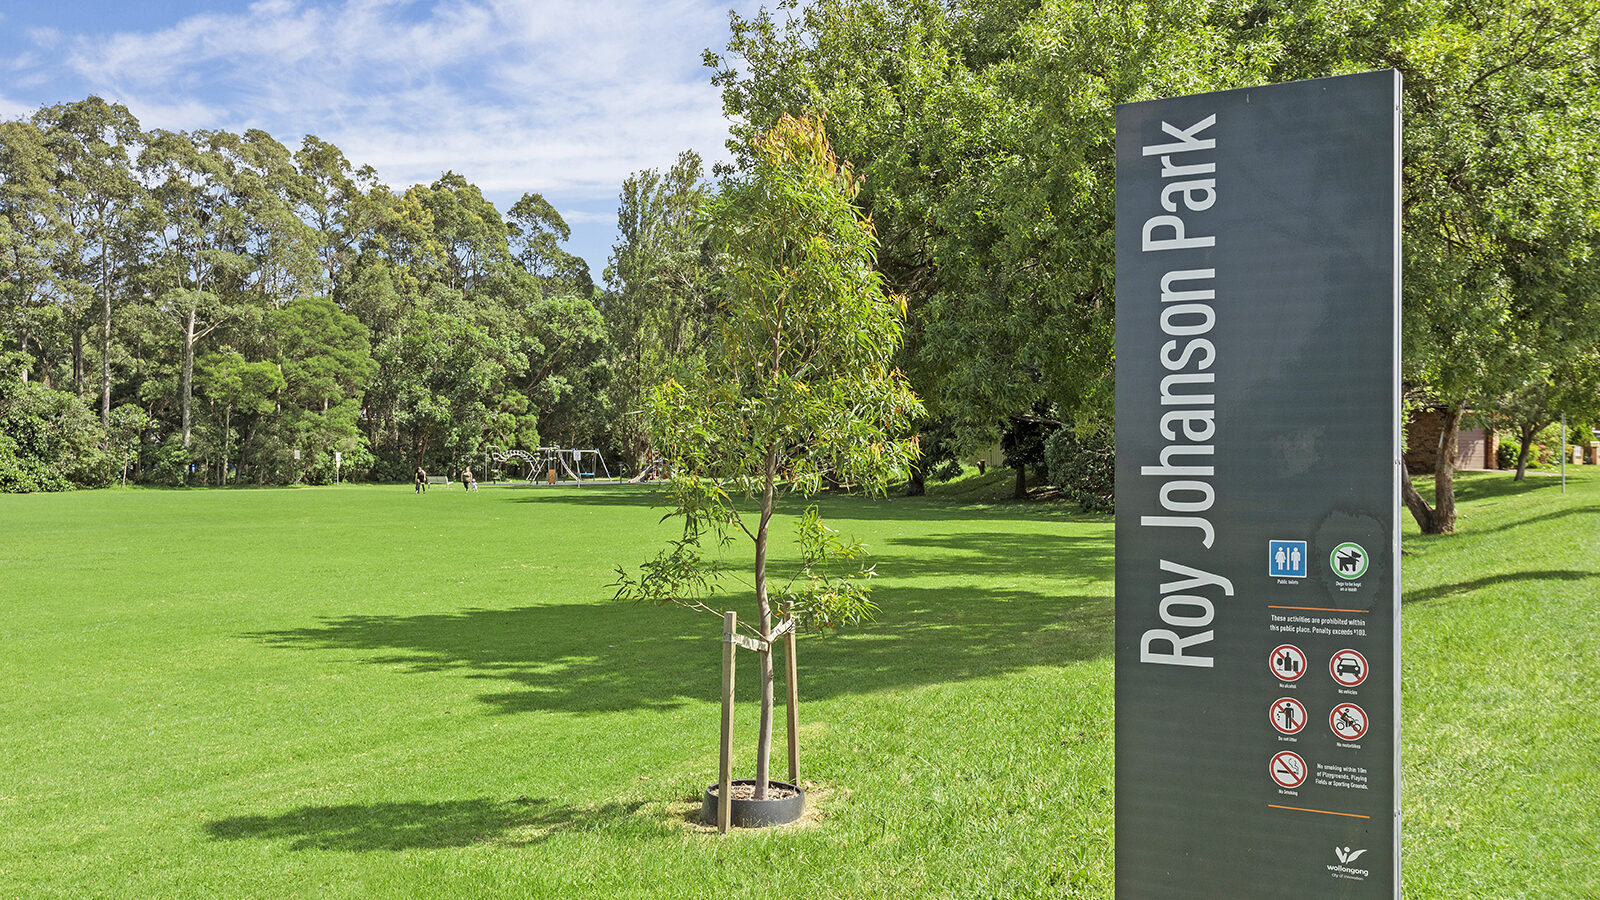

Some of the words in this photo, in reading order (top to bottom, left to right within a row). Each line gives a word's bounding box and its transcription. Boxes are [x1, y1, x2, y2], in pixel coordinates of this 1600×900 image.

[1141, 112, 1217, 253] Park
[1140, 267, 1217, 550] Johanson
[1140, 558, 1235, 668] Roy
[1321, 618, 1348, 626] prohibited
[1280, 624, 1295, 632] public
[1296, 626, 1311, 634] place.
[1312, 626, 1331, 635] Penalty
[1350, 774, 1367, 782] Playing
[1326, 864, 1369, 877] wollongong
